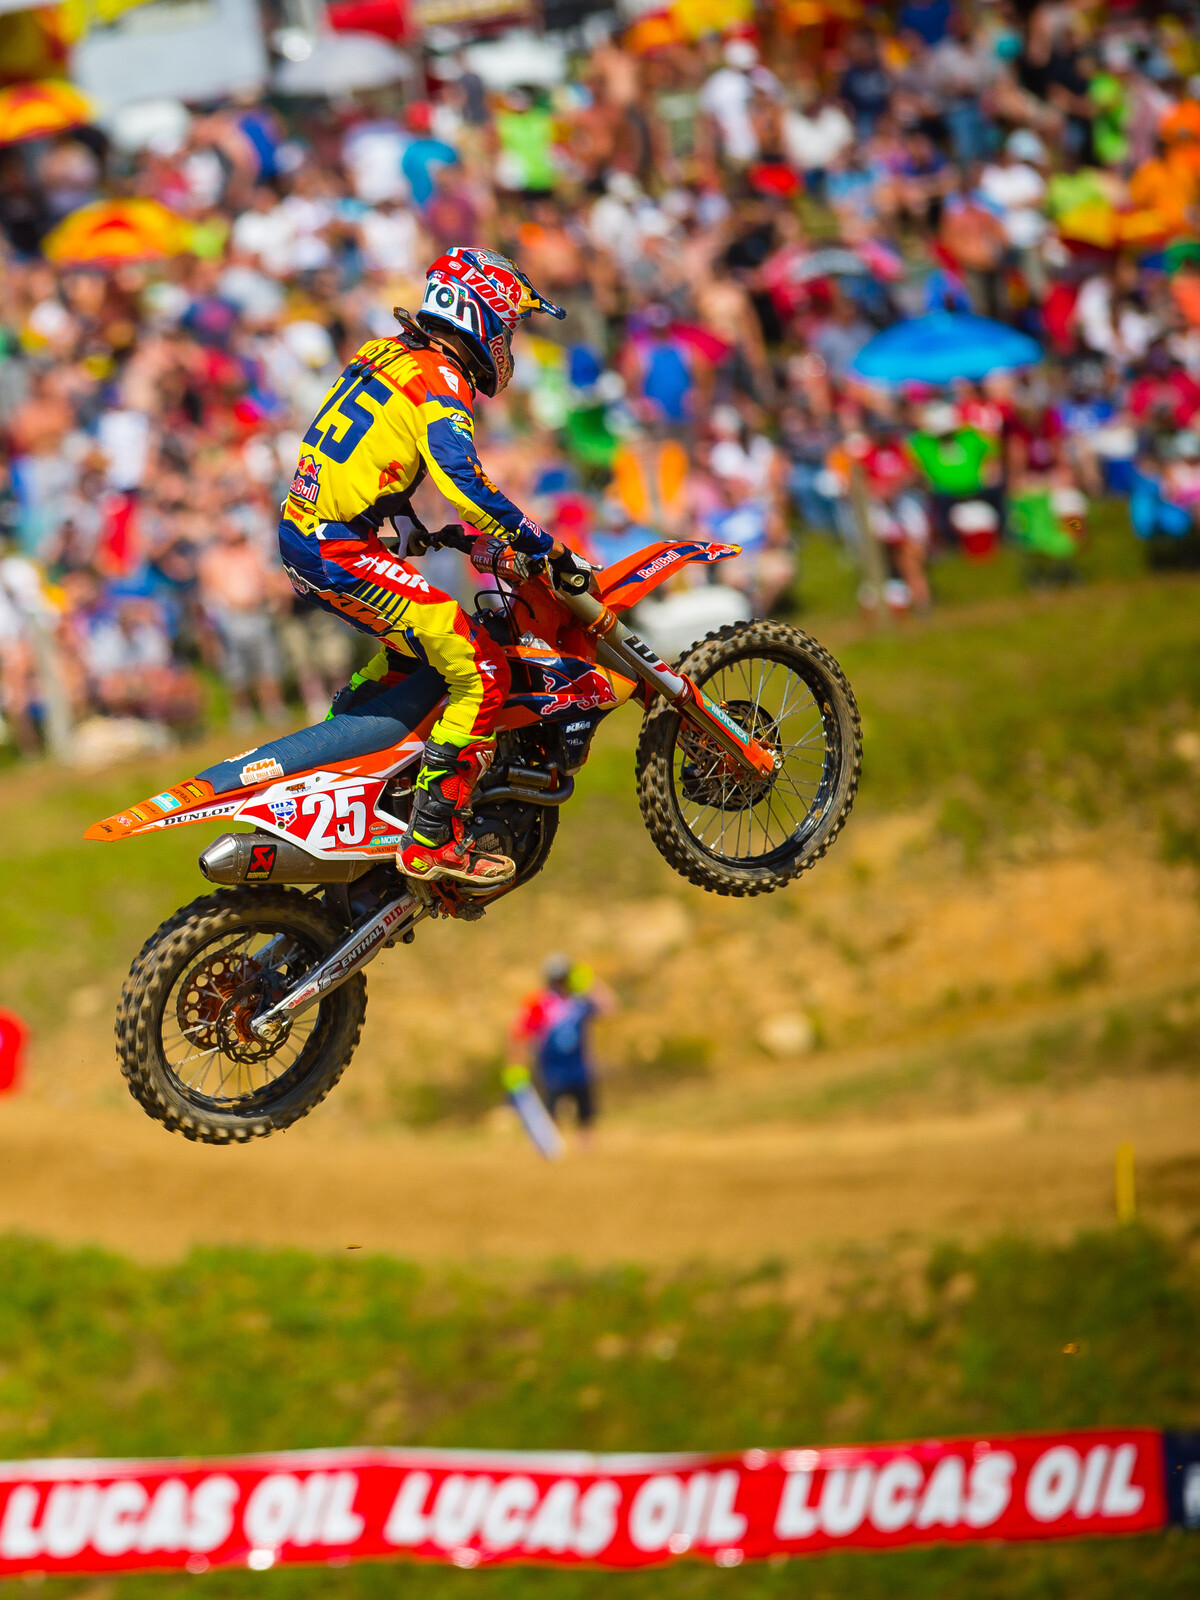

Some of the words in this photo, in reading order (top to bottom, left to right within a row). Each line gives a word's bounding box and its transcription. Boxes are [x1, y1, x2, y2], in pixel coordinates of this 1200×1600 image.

[302, 371, 393, 464] 25
[353, 554, 430, 593] THOR
[637, 560, 662, 579] Red
[657, 550, 681, 567] Bull
[317, 590, 392, 633] KTM
[566, 721, 591, 733] KTM
[711, 705, 748, 741] MOTOREX
[246, 760, 275, 773] KTM
[164, 806, 235, 826] DUNLOP
[301, 786, 367, 850] 25
[243, 1471, 366, 1550] OIL
[774, 1450, 1014, 1539] LUCAS
[1024, 1443, 1146, 1522] OIL
[384, 1471, 619, 1556] LUCAS
[629, 1470, 748, 1549] OIL
